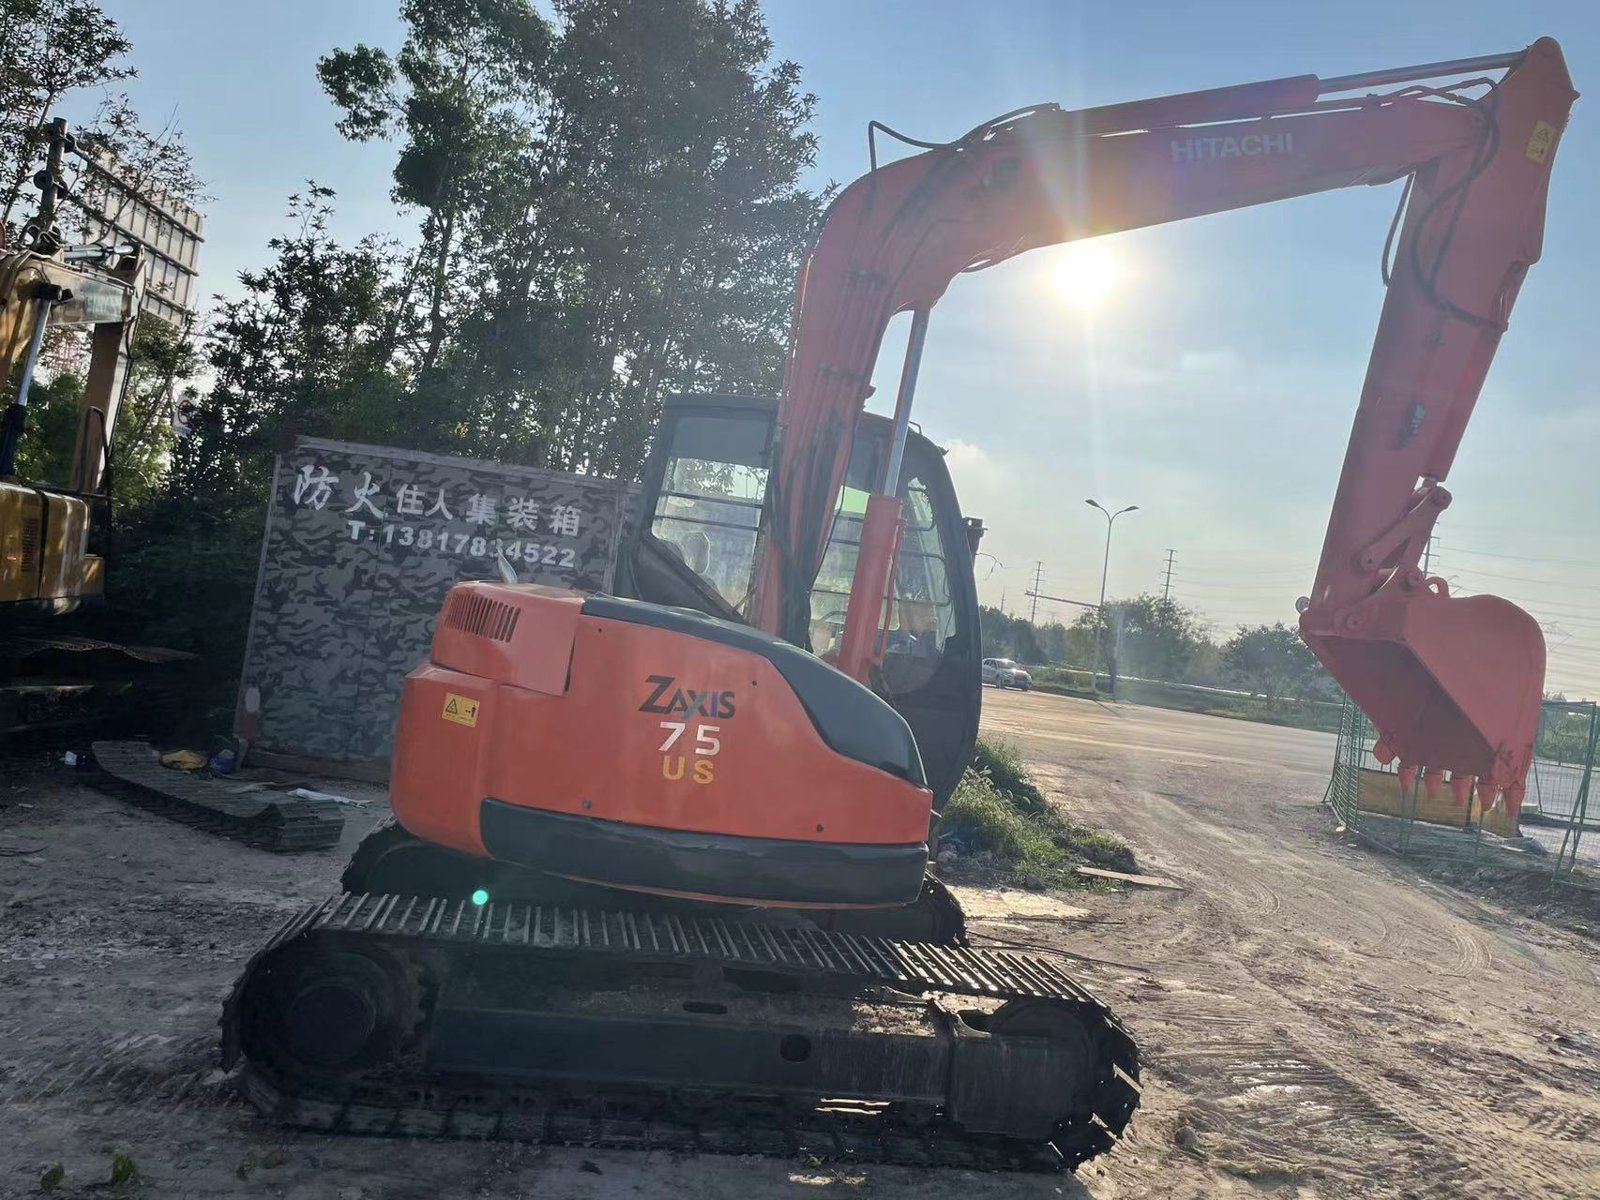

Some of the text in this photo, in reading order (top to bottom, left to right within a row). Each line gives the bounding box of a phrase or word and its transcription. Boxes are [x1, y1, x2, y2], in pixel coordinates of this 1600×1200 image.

[1171, 132, 1294, 162] HITACHI
[294, 464, 582, 537] 防火住人集装箱
[658, 721, 721, 756] 75
[662, 755, 714, 784] US
